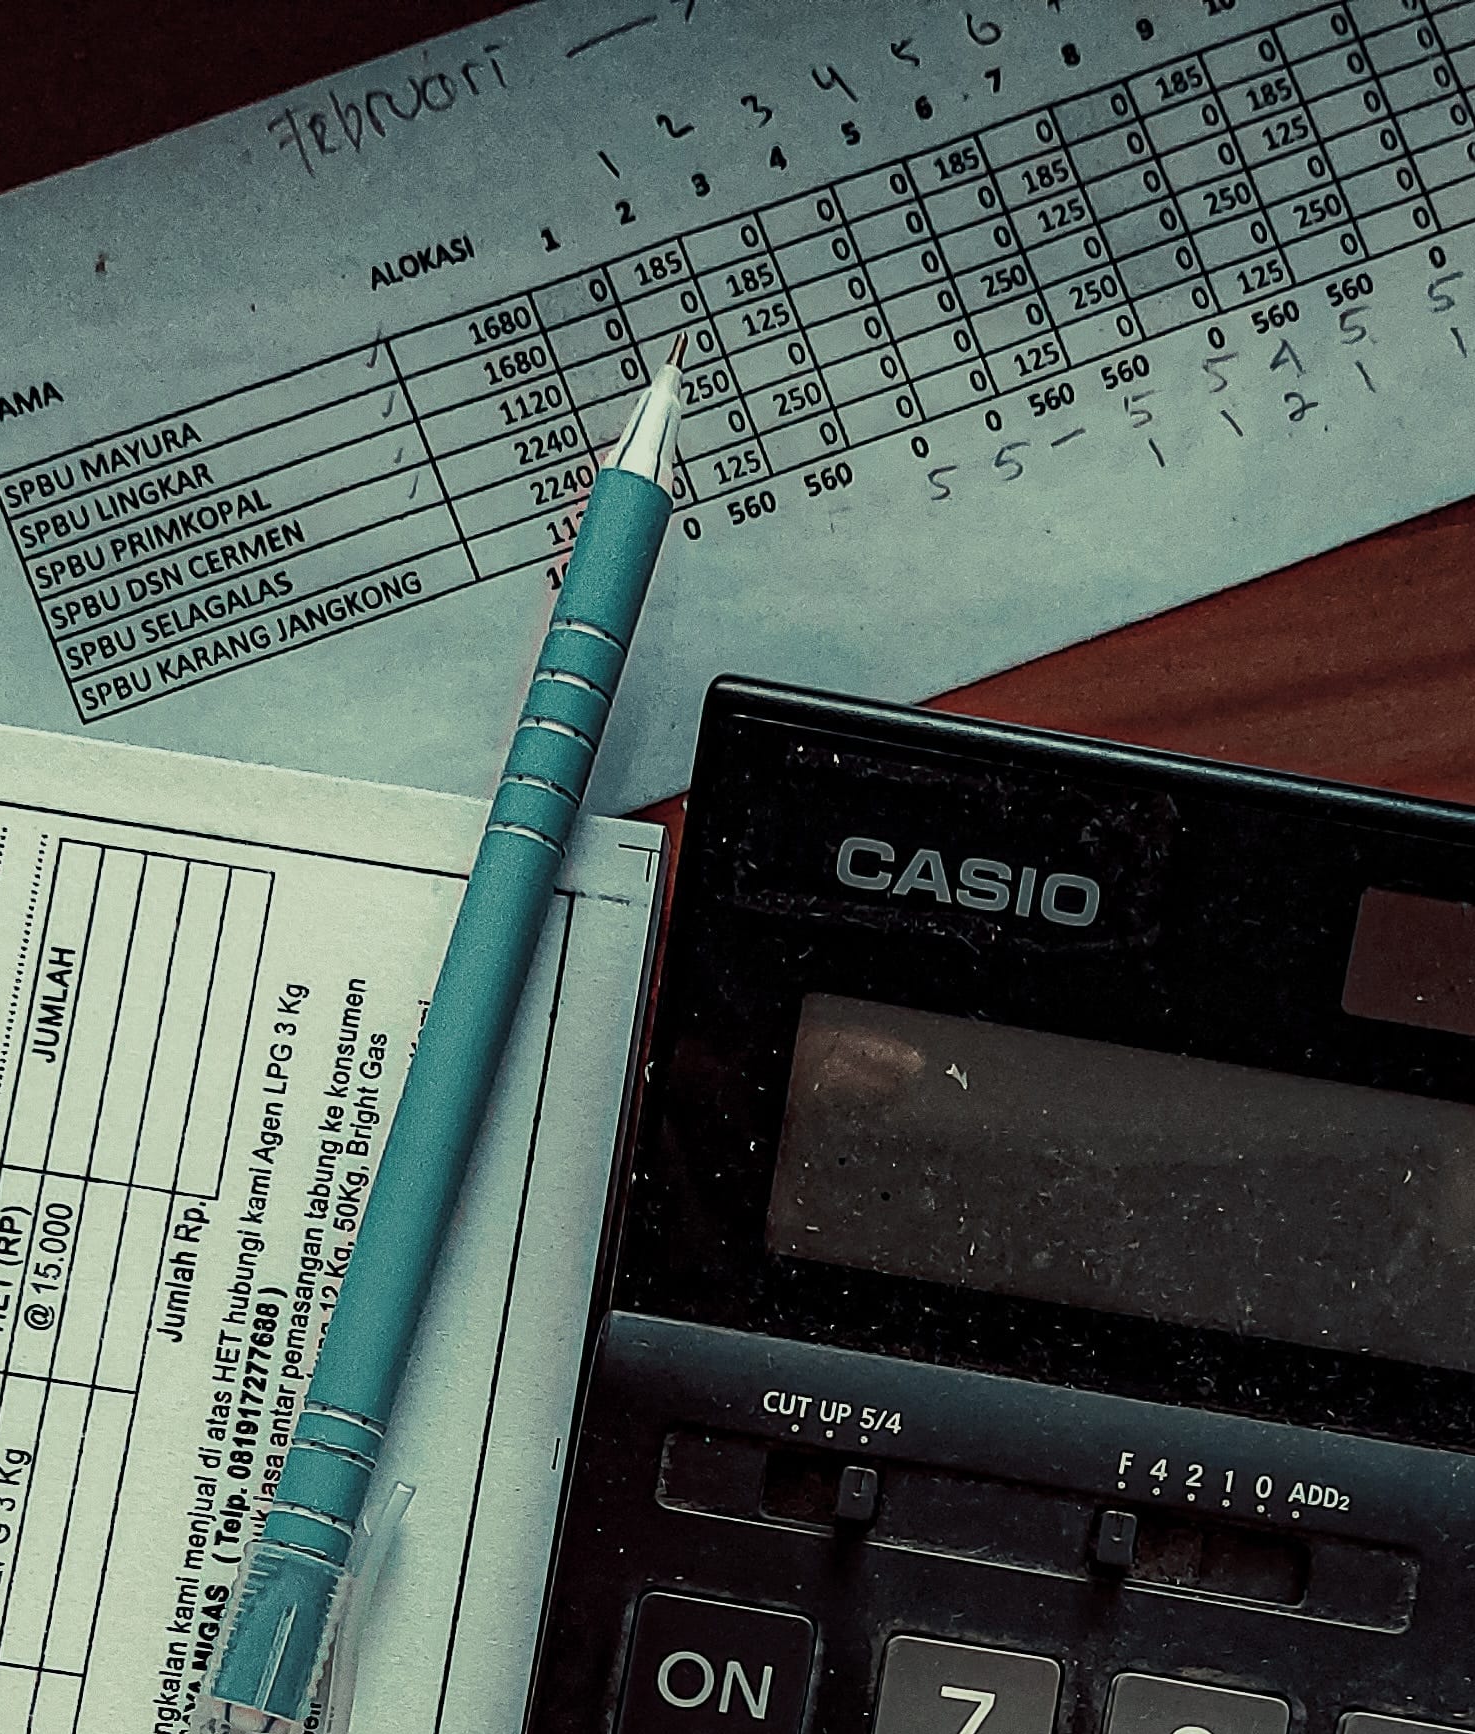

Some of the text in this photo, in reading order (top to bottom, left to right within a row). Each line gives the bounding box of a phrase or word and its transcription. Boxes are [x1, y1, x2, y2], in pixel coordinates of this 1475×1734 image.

[372, 235, 474, 290] ALOKASI
[5, 250, 682, 508] SPBU MAYURA 1680 185
[20, 263, 774, 548] SPBU LINGKAR 1680 185
[35, 303, 790, 589] SPBU PRIMKOPAL 1120 125
[51, 425, 578, 630] SPBU DSN CERMEN 2240
[66, 382, 821, 670] SPBU SELAGALAS 2240 250
[81, 572, 421, 711] SPBU KARANG JANGKONG
[835, 835, 1101, 927] CASIO
[32, 947, 75, 1063] JUMLAH
[274, 1022, 296, 1036] 3
[277, 984, 309, 1014] Kg
[263, 1044, 292, 1094] LPG
[359, 1034, 387, 1079] Gas
[252, 1103, 283, 1164] Agen
[346, 1087, 380, 1156] Bright
[239, 1168, 272, 1224] kami
[270, 979, 366, 1447] antar pemasangan tabung ke konsumen
[31, 1203, 73, 1293] 15.000
[157, 1202, 210, 1342] Jumlah Rp.
[222, 1230, 265, 1324] hubungi
[24, 1304, 55, 1330] @
[212, 1329, 242, 1382] HET
[206, 1391, 232, 1441] atas
[762, 1390, 903, 1435] CUT UP 5/4
[198, 1447, 222, 1468] di
[1117, 1451, 1135, 1476] F
[1149, 1458, 1169, 1482] 4
[1185, 1464, 1204, 1488] 2
[1223, 1469, 1235, 1493] 1
[184, 1476, 221, 1569] menjual
[166, 1577, 199, 1633] kami
[657, 1650, 774, 1720] ON
